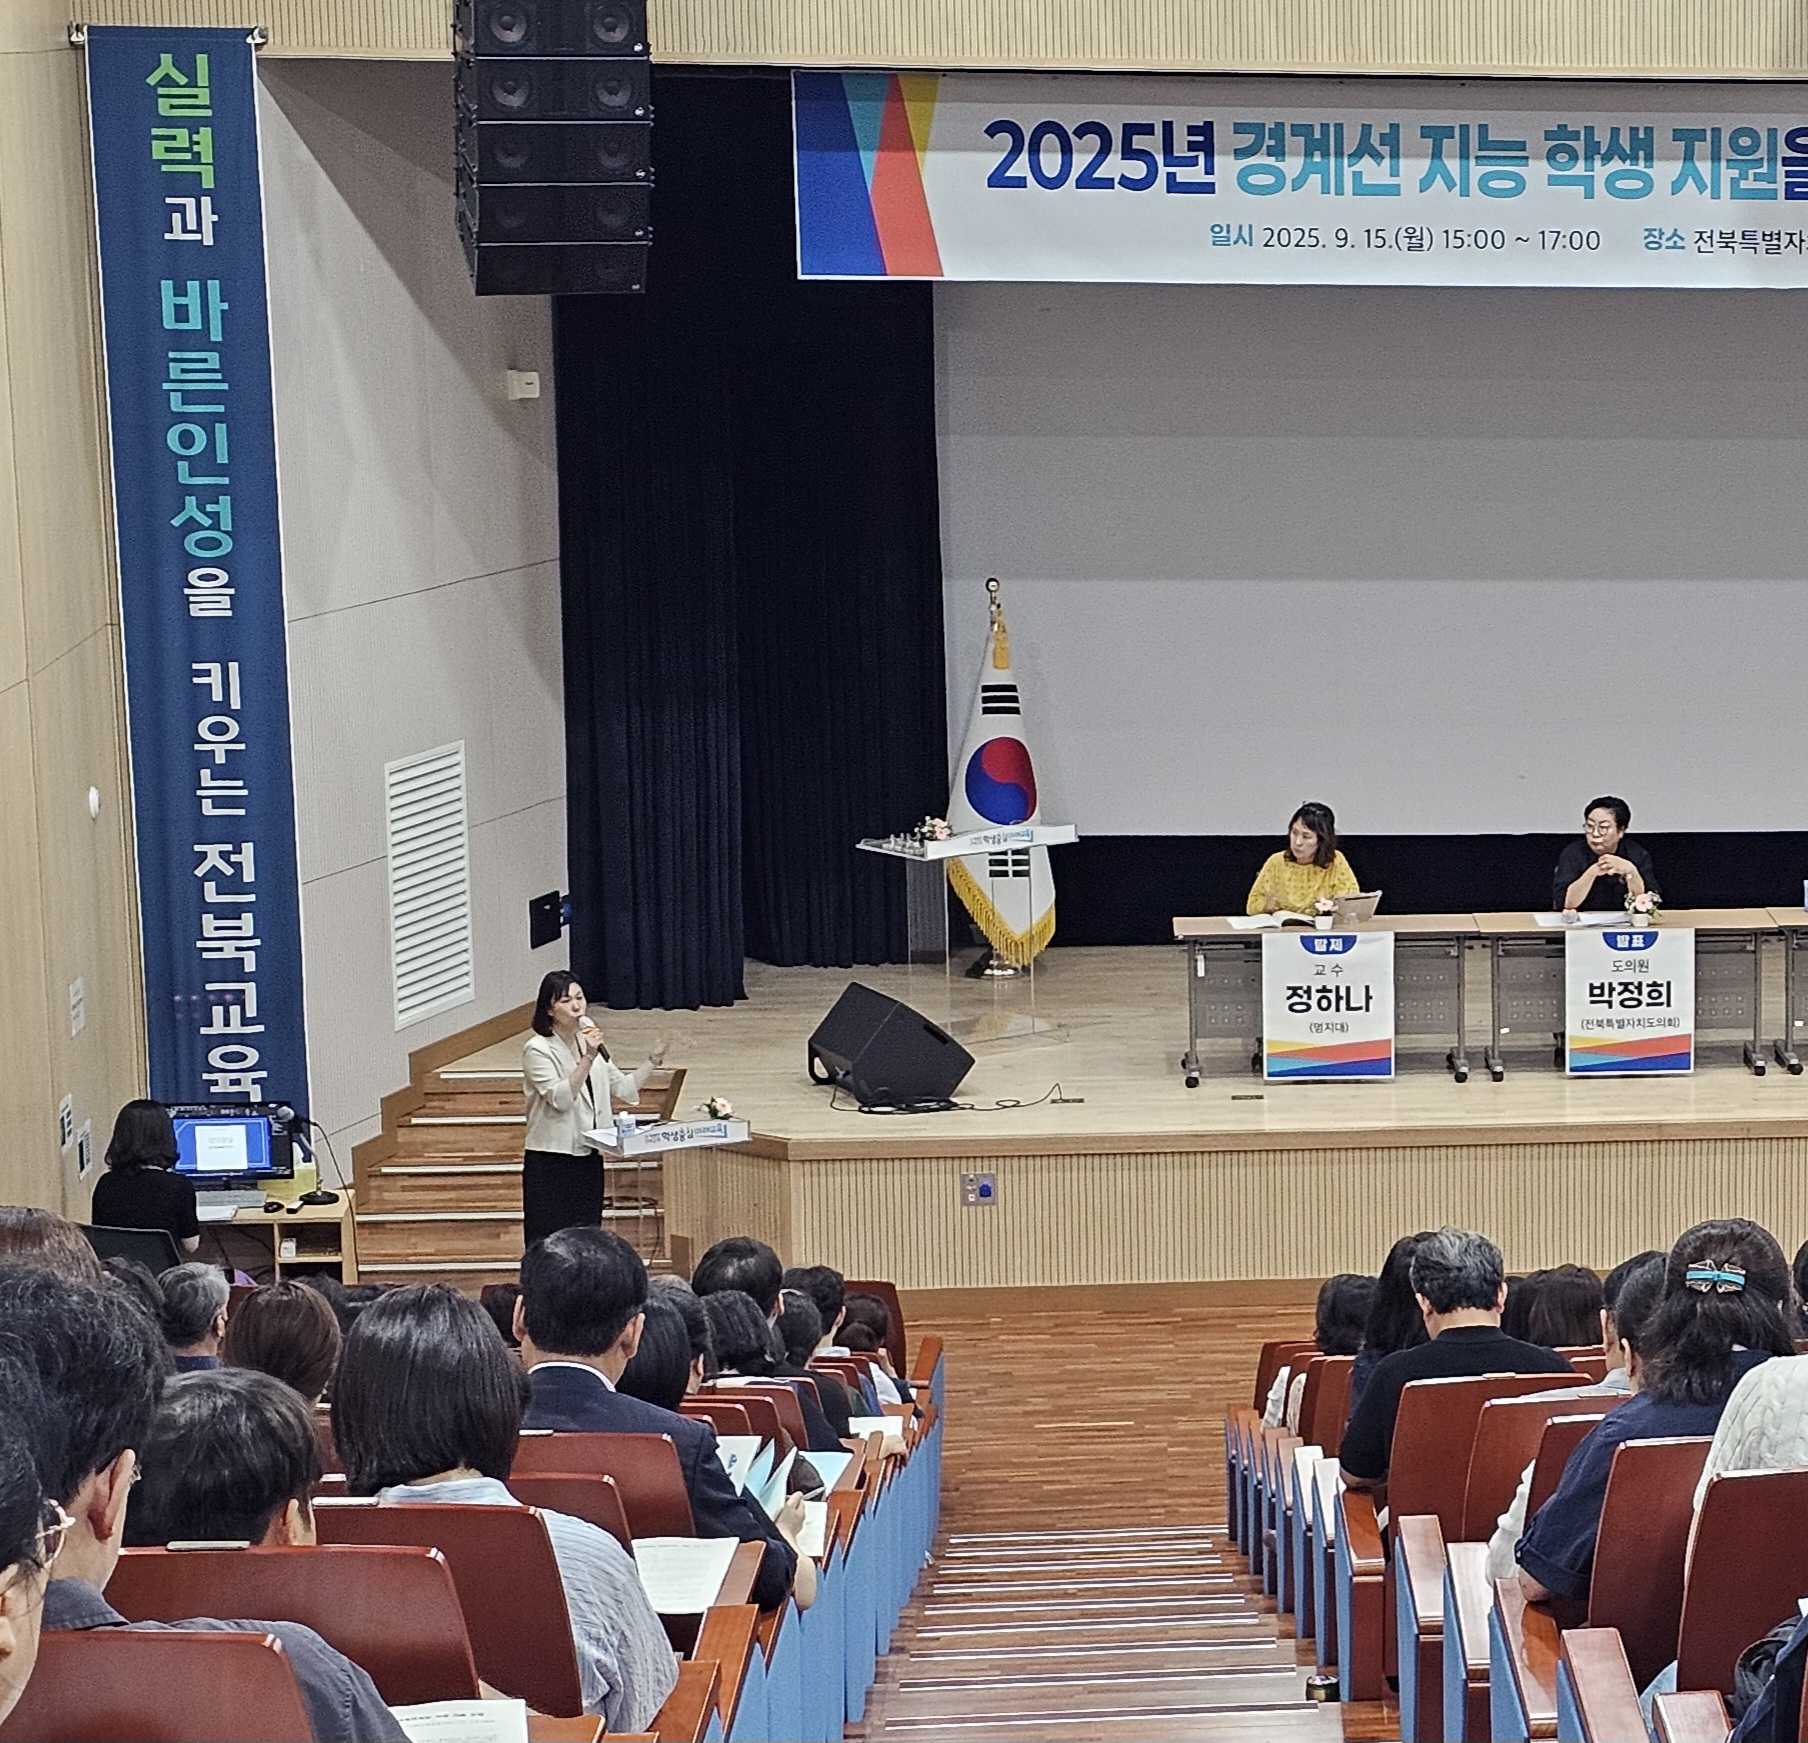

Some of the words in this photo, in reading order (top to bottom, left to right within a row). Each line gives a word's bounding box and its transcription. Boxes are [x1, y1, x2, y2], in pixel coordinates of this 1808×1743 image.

[145, 52, 220, 246] 실력과
[983, 119, 1217, 195] 2025년
[1232, 121, 1402, 197] 경계선
[1419, 123, 1530, 199] 지능
[1543, 124, 1655, 200] 학생
[1209, 223, 1254, 248] 일시
[1262, 227, 1327, 249] 2025.
[1335, 228, 1356, 249] 9.
[1363, 225, 1434, 253] 15.(월)
[1443, 229, 1506, 251] 15:00
[1538, 230, 1602, 252] 17:00
[1643, 227, 1687, 252] 장소
[159, 279, 236, 619] 바른인성을
[191, 661, 249, 817] 키우는
[193, 842, 269, 1102] 전북교육
[1611, 958, 1650, 974] 도의원
[1285, 984, 1374, 1014] 정하나
[1588, 980, 1672, 1010] 박정희
